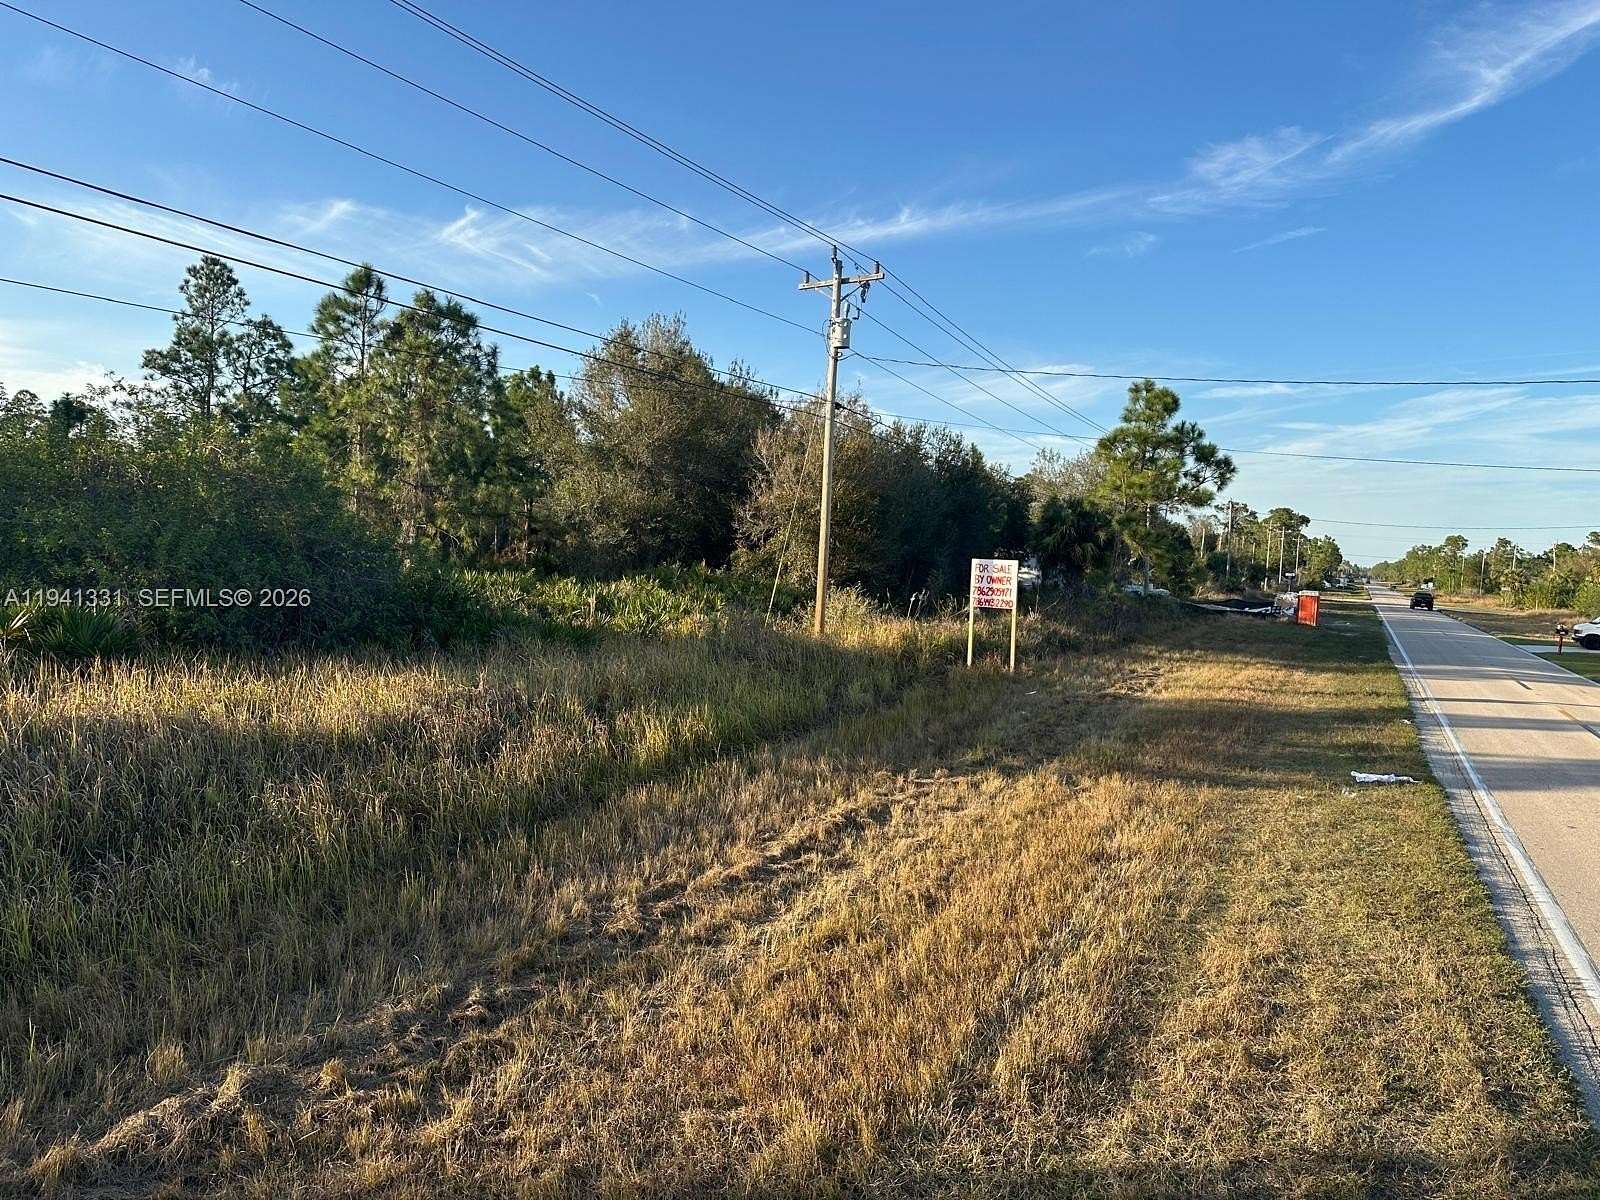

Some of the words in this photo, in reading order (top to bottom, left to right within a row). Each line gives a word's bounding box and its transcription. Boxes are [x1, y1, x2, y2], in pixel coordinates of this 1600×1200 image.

[975, 563, 989, 573] FOR
[992, 564, 1013, 574] SALE
[975, 574, 984, 583] BY
[986, 575, 1012, 586] OWNER
